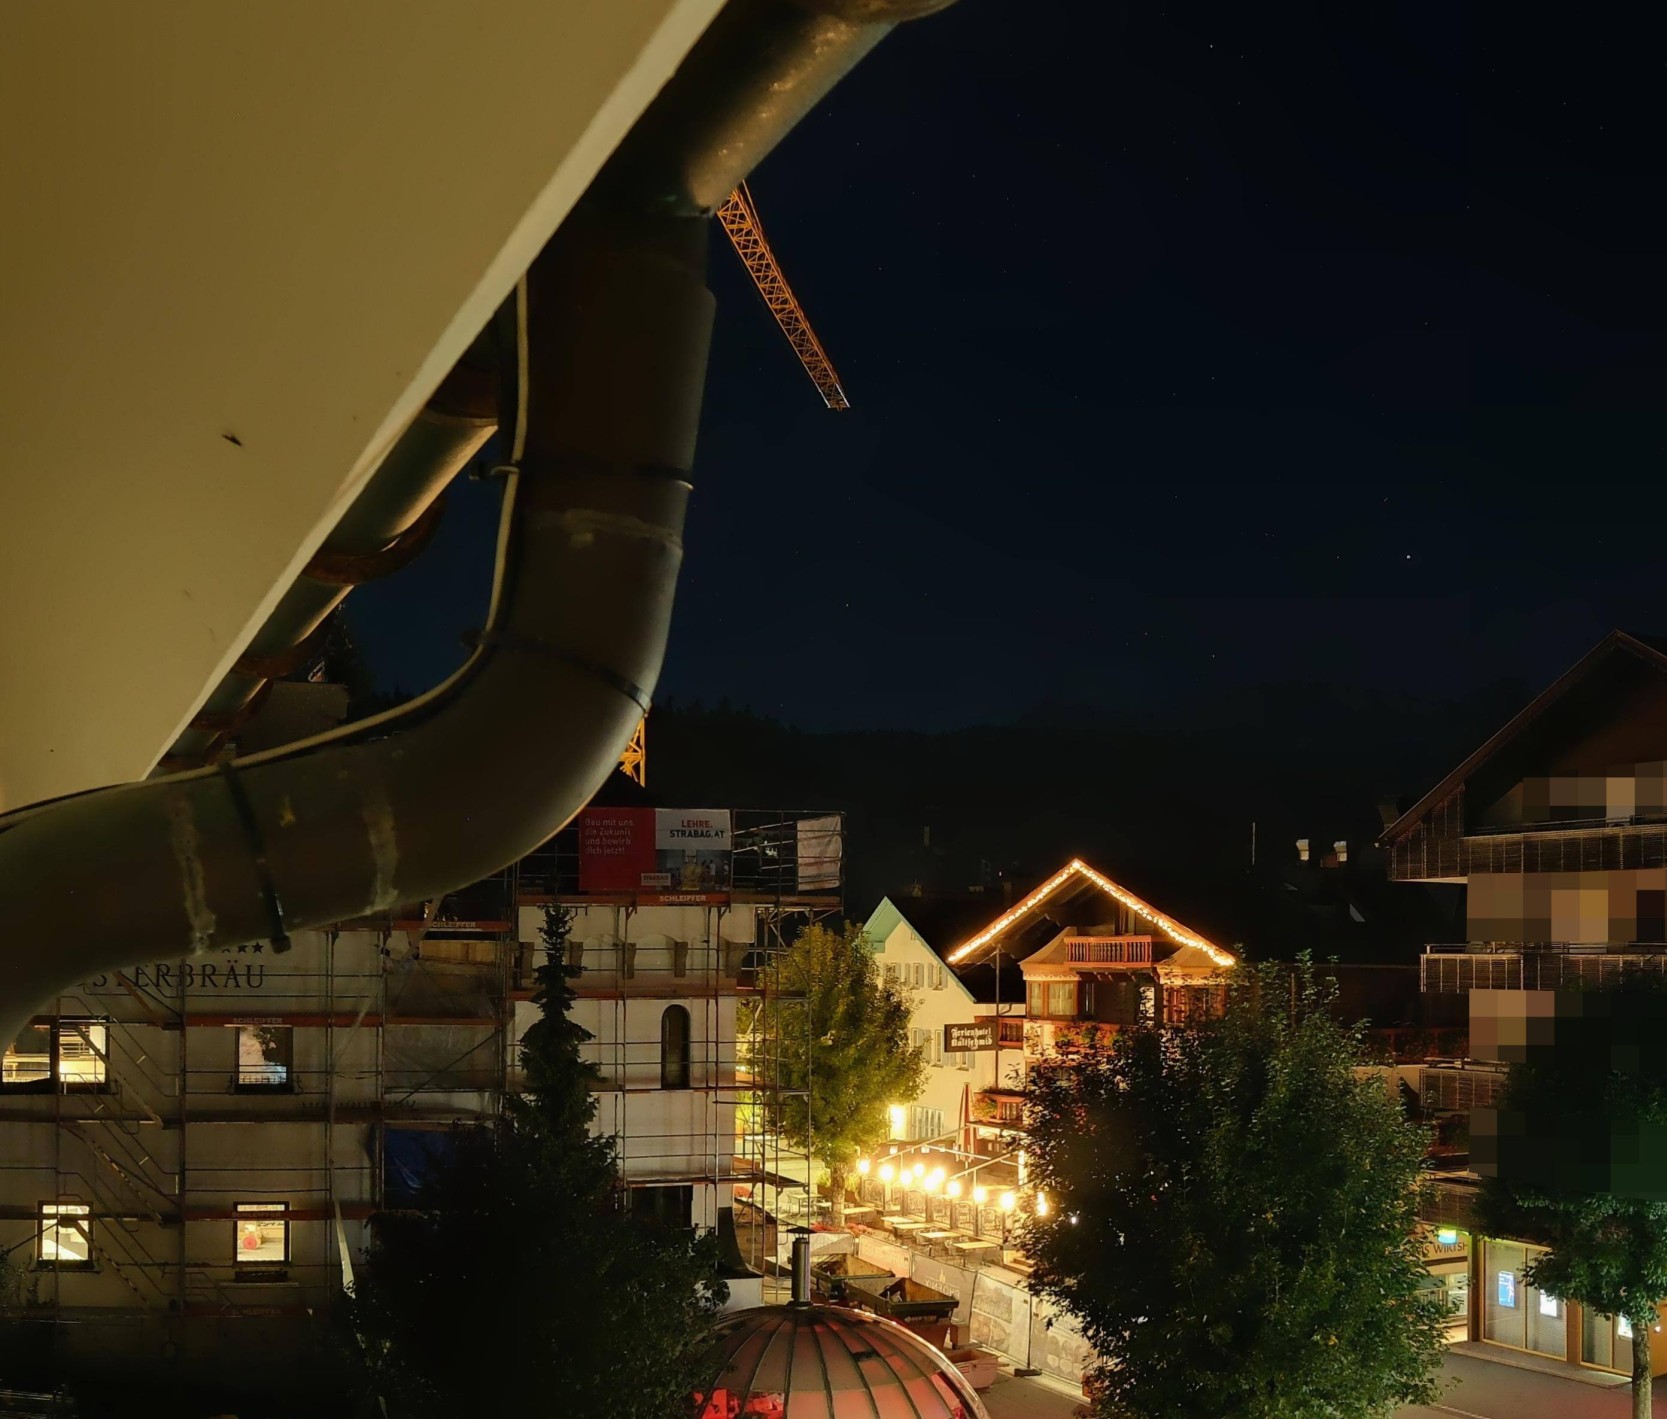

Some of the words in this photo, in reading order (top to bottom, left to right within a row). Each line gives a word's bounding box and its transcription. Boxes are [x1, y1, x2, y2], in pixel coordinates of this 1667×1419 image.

[602, 817, 617, 827] mit
[682, 819, 713, 829] LEHRE.
[585, 827, 598, 836] die
[668, 829, 725, 839] STRABAG.AT
[585, 837, 600, 846] und
[602, 837, 632, 846] bewirb
[585, 846, 602, 855] dich
